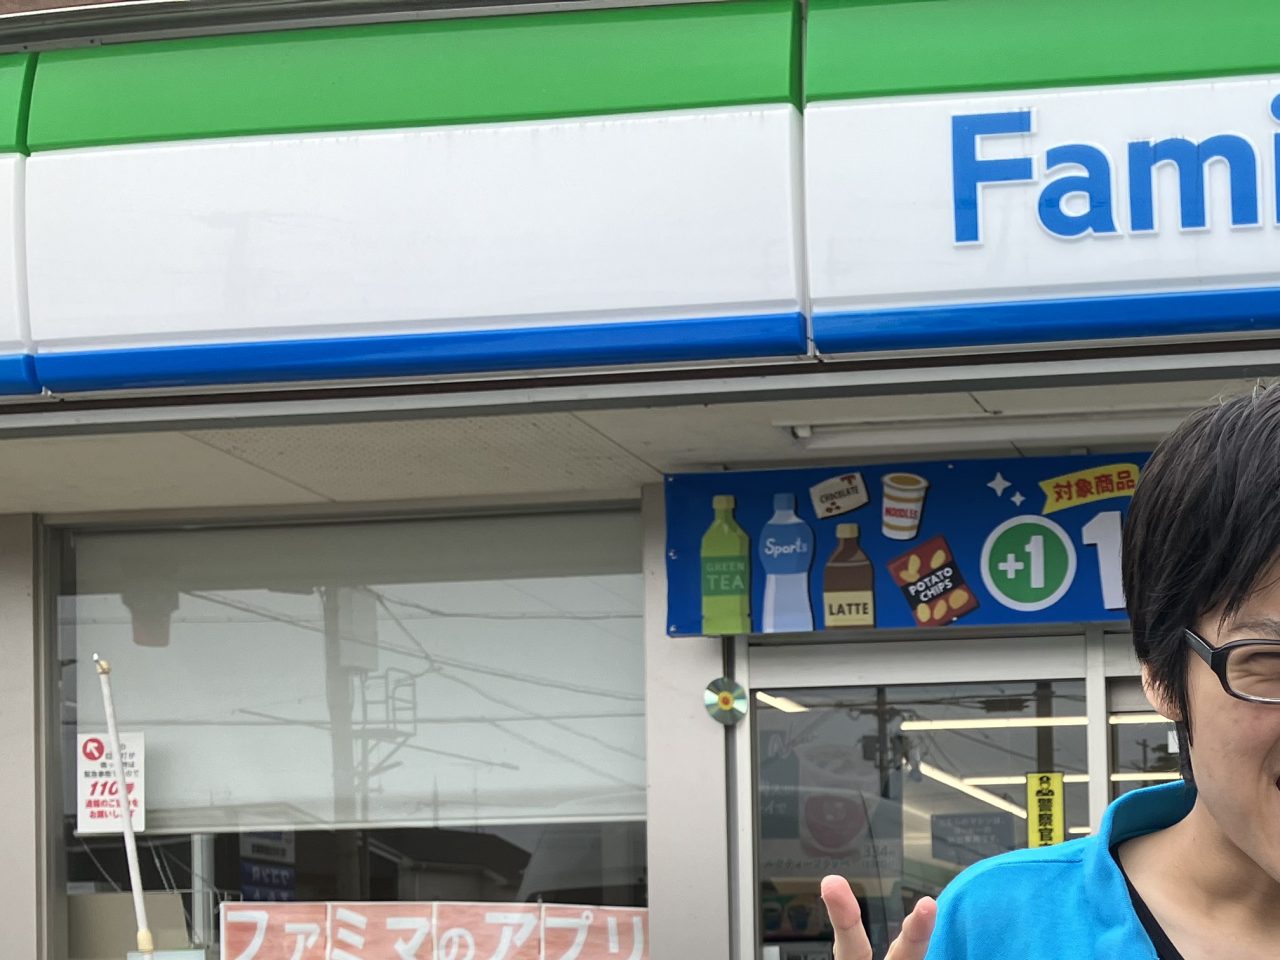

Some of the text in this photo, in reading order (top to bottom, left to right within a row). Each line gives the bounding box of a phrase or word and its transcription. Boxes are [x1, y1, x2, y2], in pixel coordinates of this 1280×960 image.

[819, 486, 860, 505] CHOCOLATE
[1053, 470, 1136, 502] 対象商品
[885, 507, 919, 519] NOODLES
[764, 538, 808, 559] Sports
[706, 561, 745, 572] GREEN
[706, 575, 745, 591] TEA
[908, 567, 953, 597] POTATO
[920, 579, 953, 602] CHIPS
[828, 602, 870, 617] LATTE
